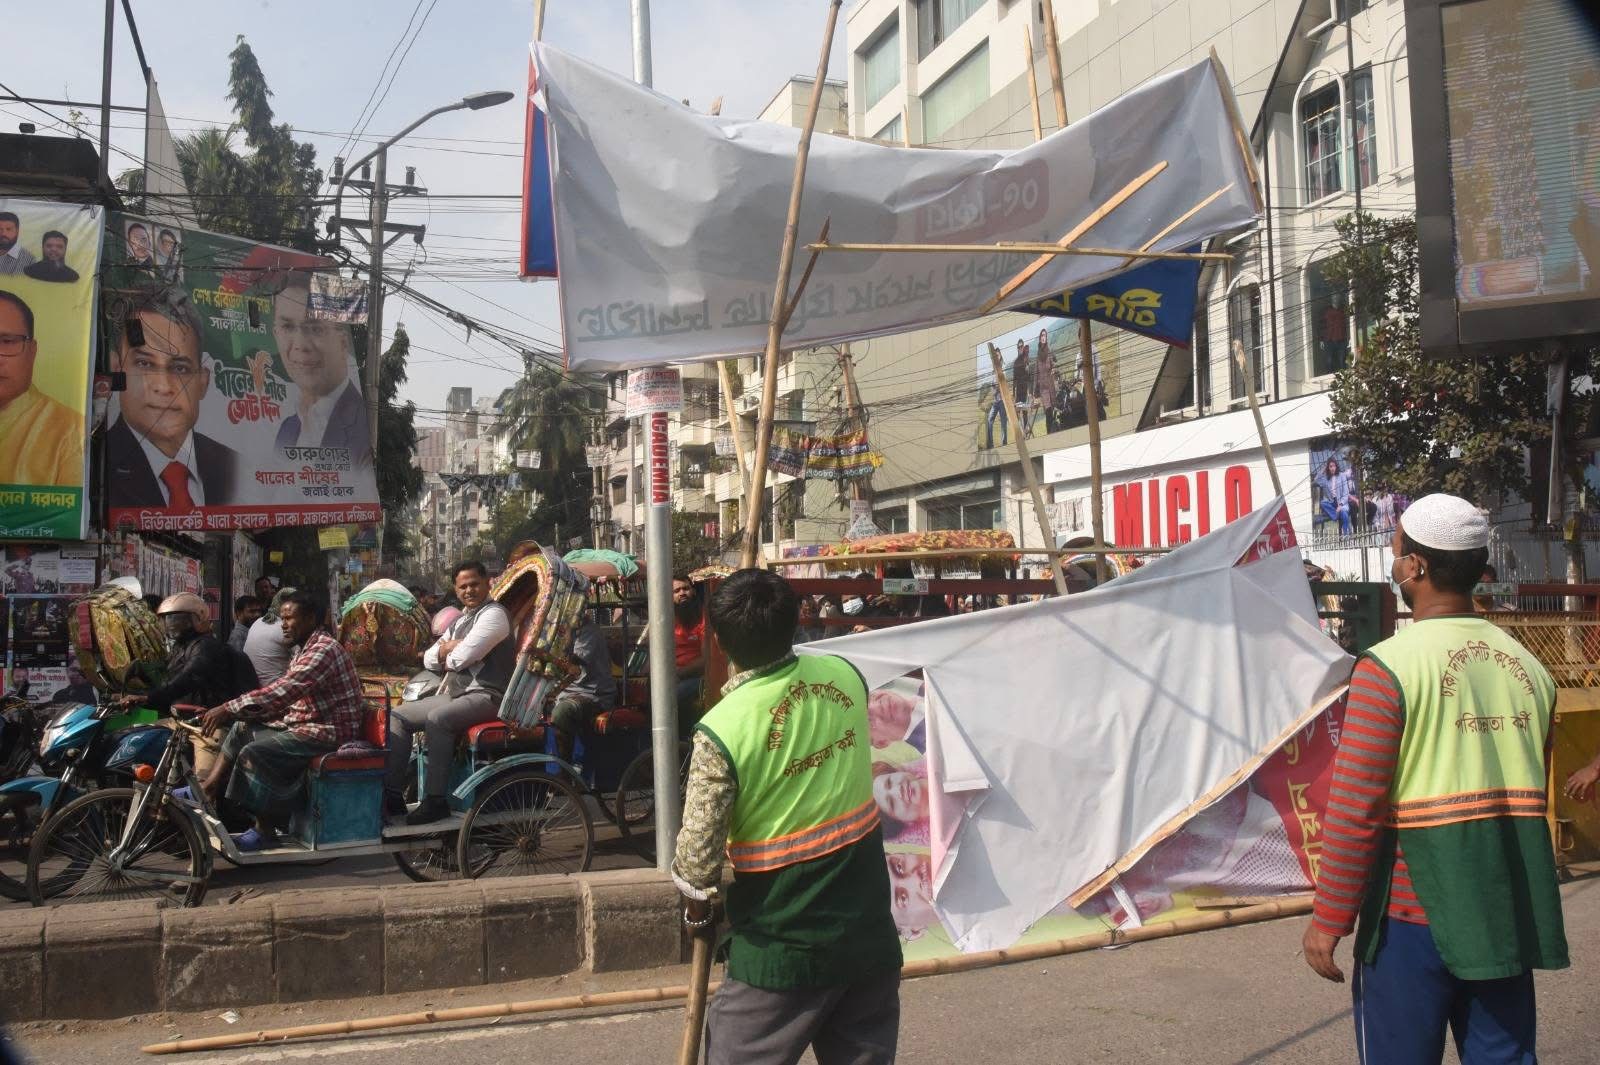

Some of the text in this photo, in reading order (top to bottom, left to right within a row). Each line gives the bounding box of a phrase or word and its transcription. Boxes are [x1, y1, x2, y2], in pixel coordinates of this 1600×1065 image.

[255, 470, 296, 485] ধানের
[332, 486, 354, 496] হোক
[140, 510, 203, 530] নিউমার্কেট
[207, 514, 230, 529] থানা
[275, 512, 300, 527] ঢাকা
[302, 511, 343, 525] মহানগর
[346, 505, 376, 522] দক্ষিণ
[1440, 670, 1459, 697] ঢাকা
